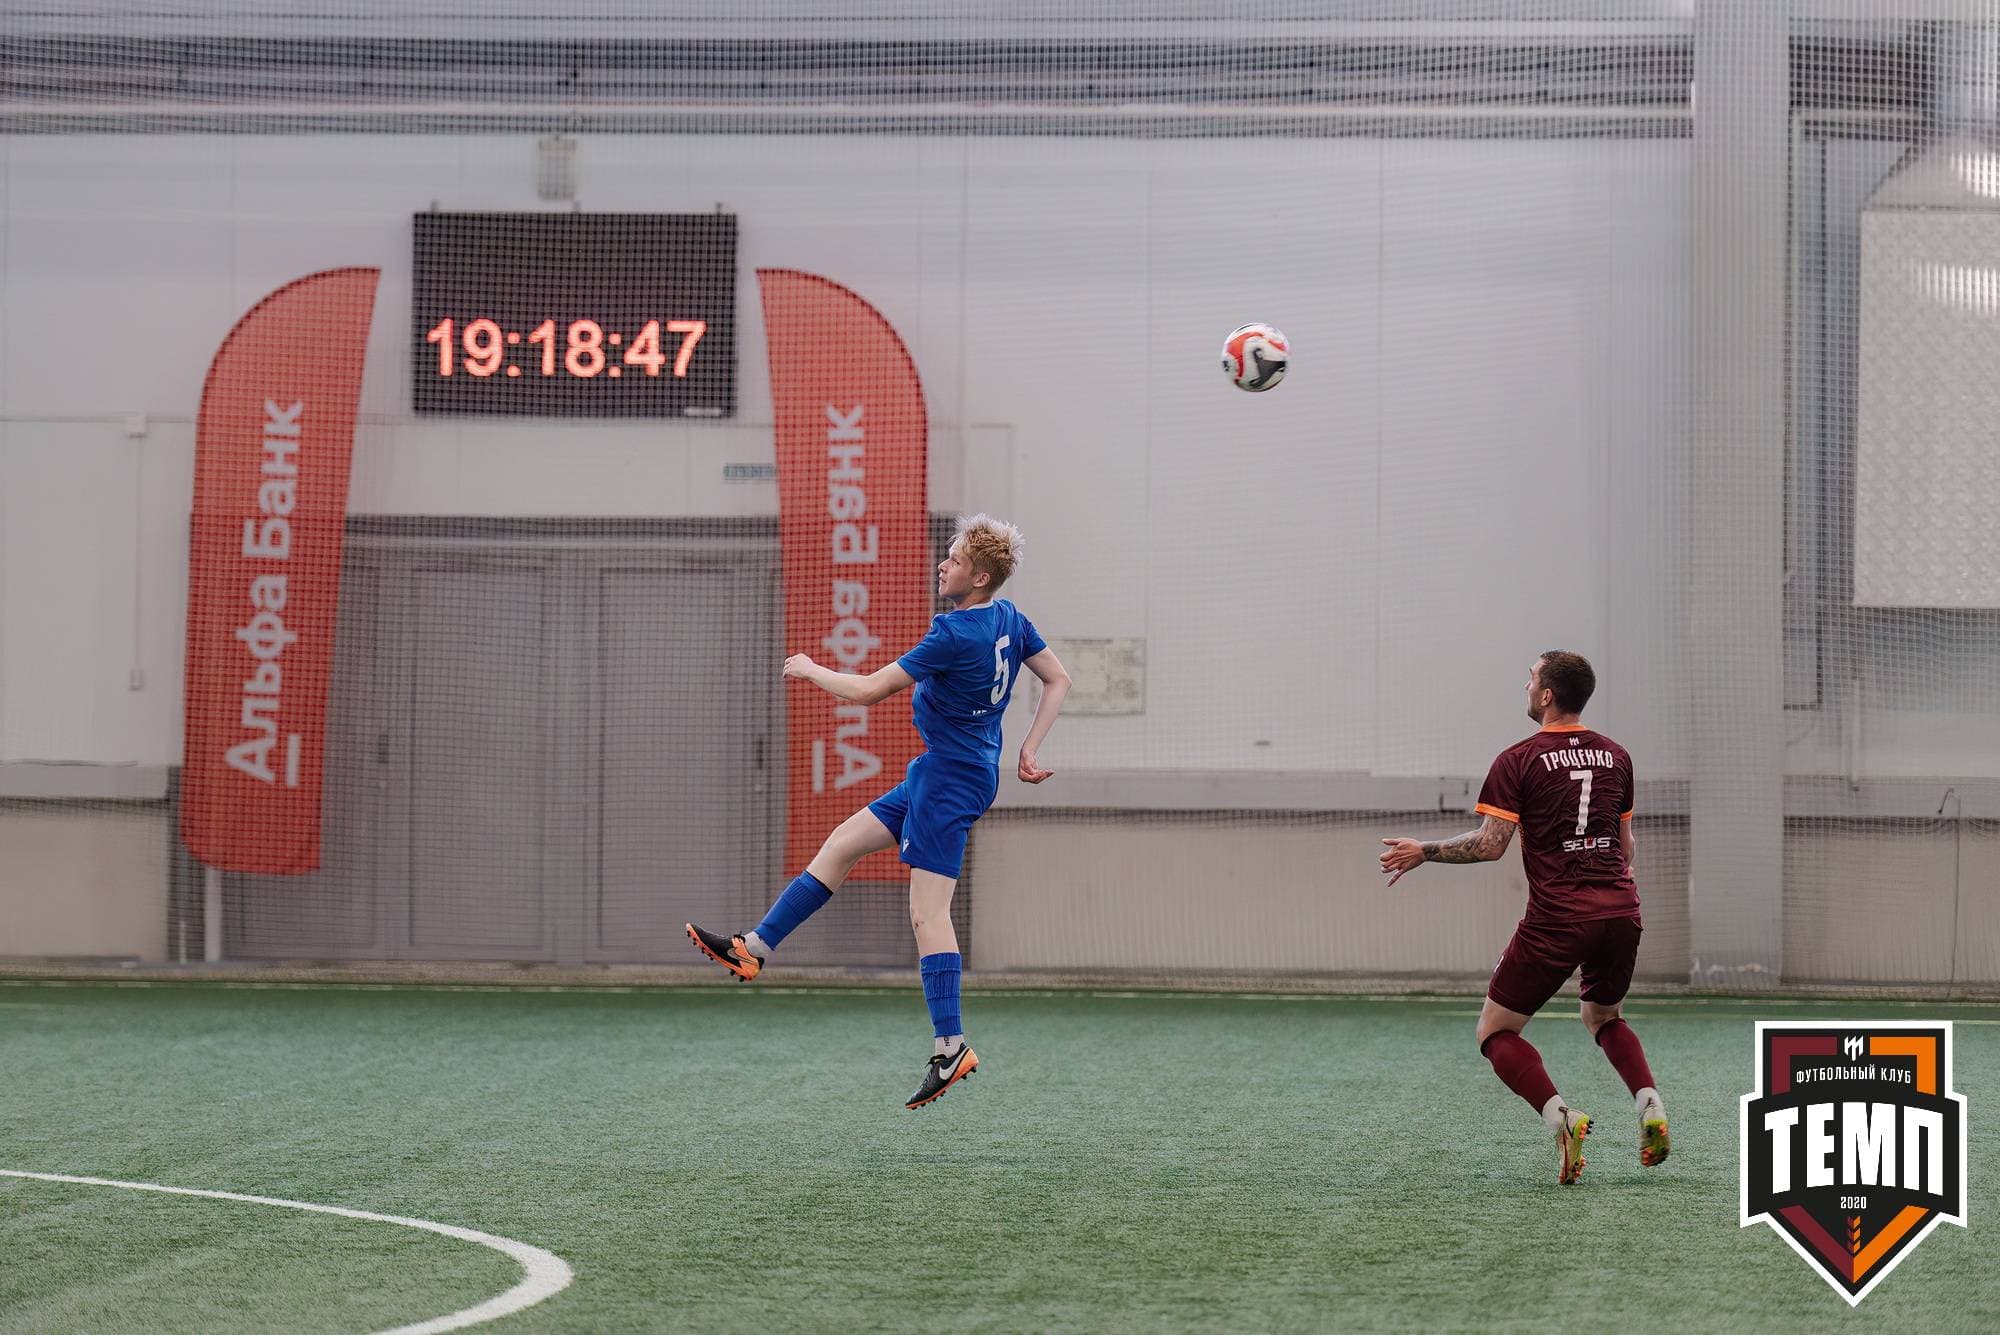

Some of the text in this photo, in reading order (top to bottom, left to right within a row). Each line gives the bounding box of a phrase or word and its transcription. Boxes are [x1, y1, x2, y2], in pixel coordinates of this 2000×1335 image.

[426, 317, 708, 378] 19:18:47
[224, 398, 304, 785] Альфа Банк
[990, 634, 1010, 705] 5
[1540, 749, 1614, 772] ТРОЦЕНКО
[1569, 769, 1593, 835] 7
